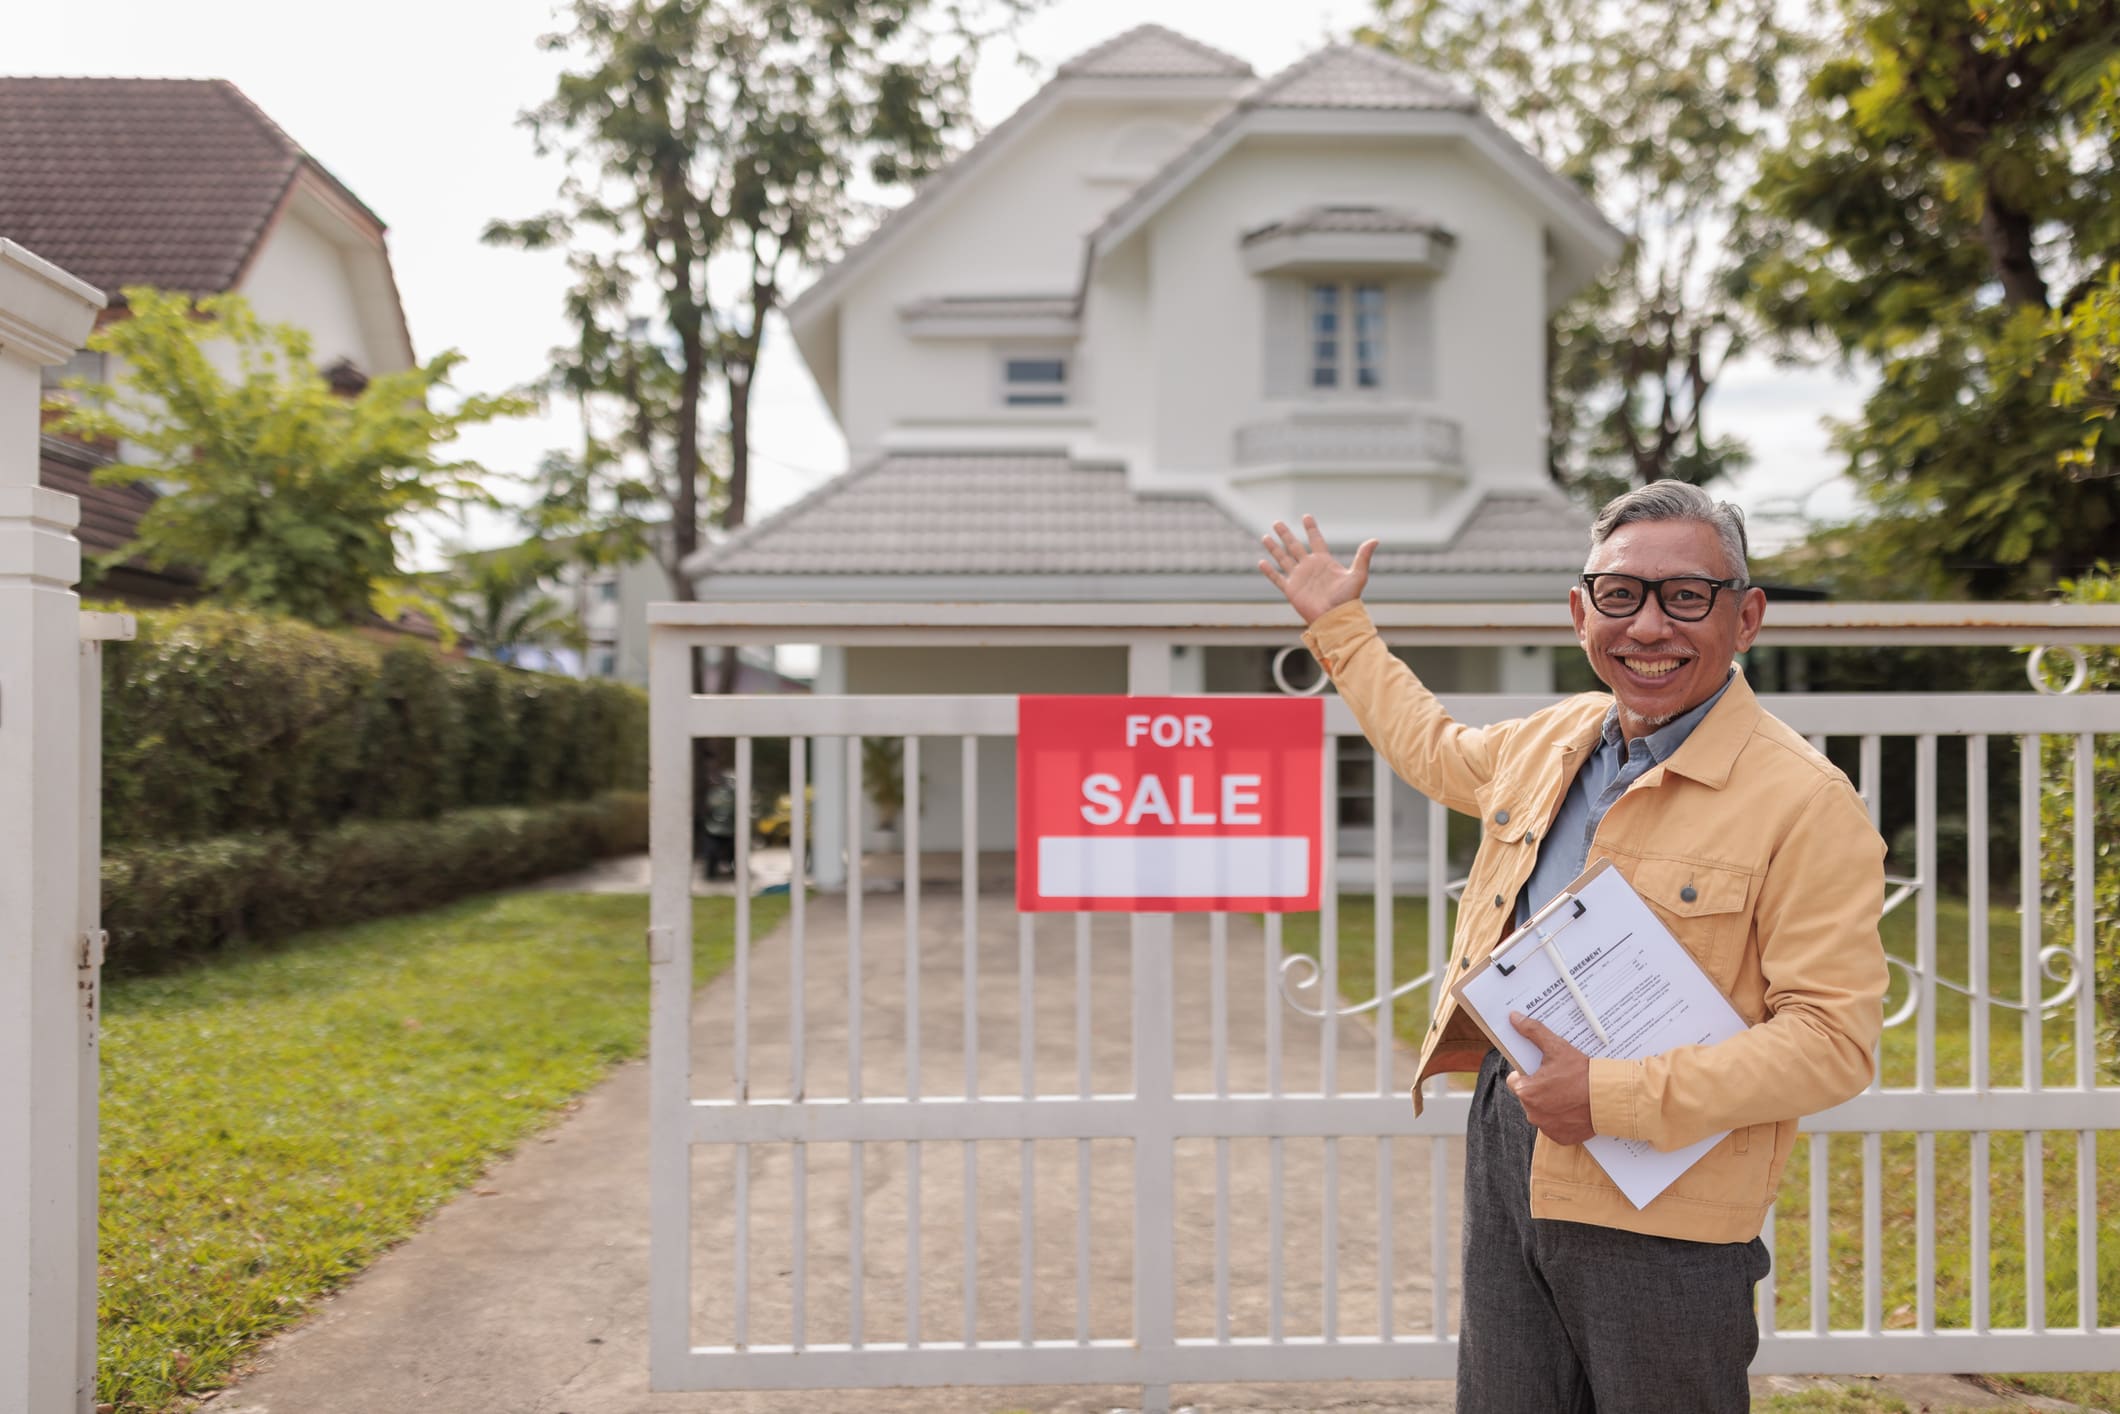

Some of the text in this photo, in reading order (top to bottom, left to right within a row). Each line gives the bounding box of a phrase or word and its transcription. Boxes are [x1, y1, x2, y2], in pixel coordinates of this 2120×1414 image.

[1126, 714, 1213, 747] FOR
[1080, 773, 1261, 825] SALE
[1526, 996, 1543, 1010] REAL
[1569, 947, 1603, 976] GREEMENT
